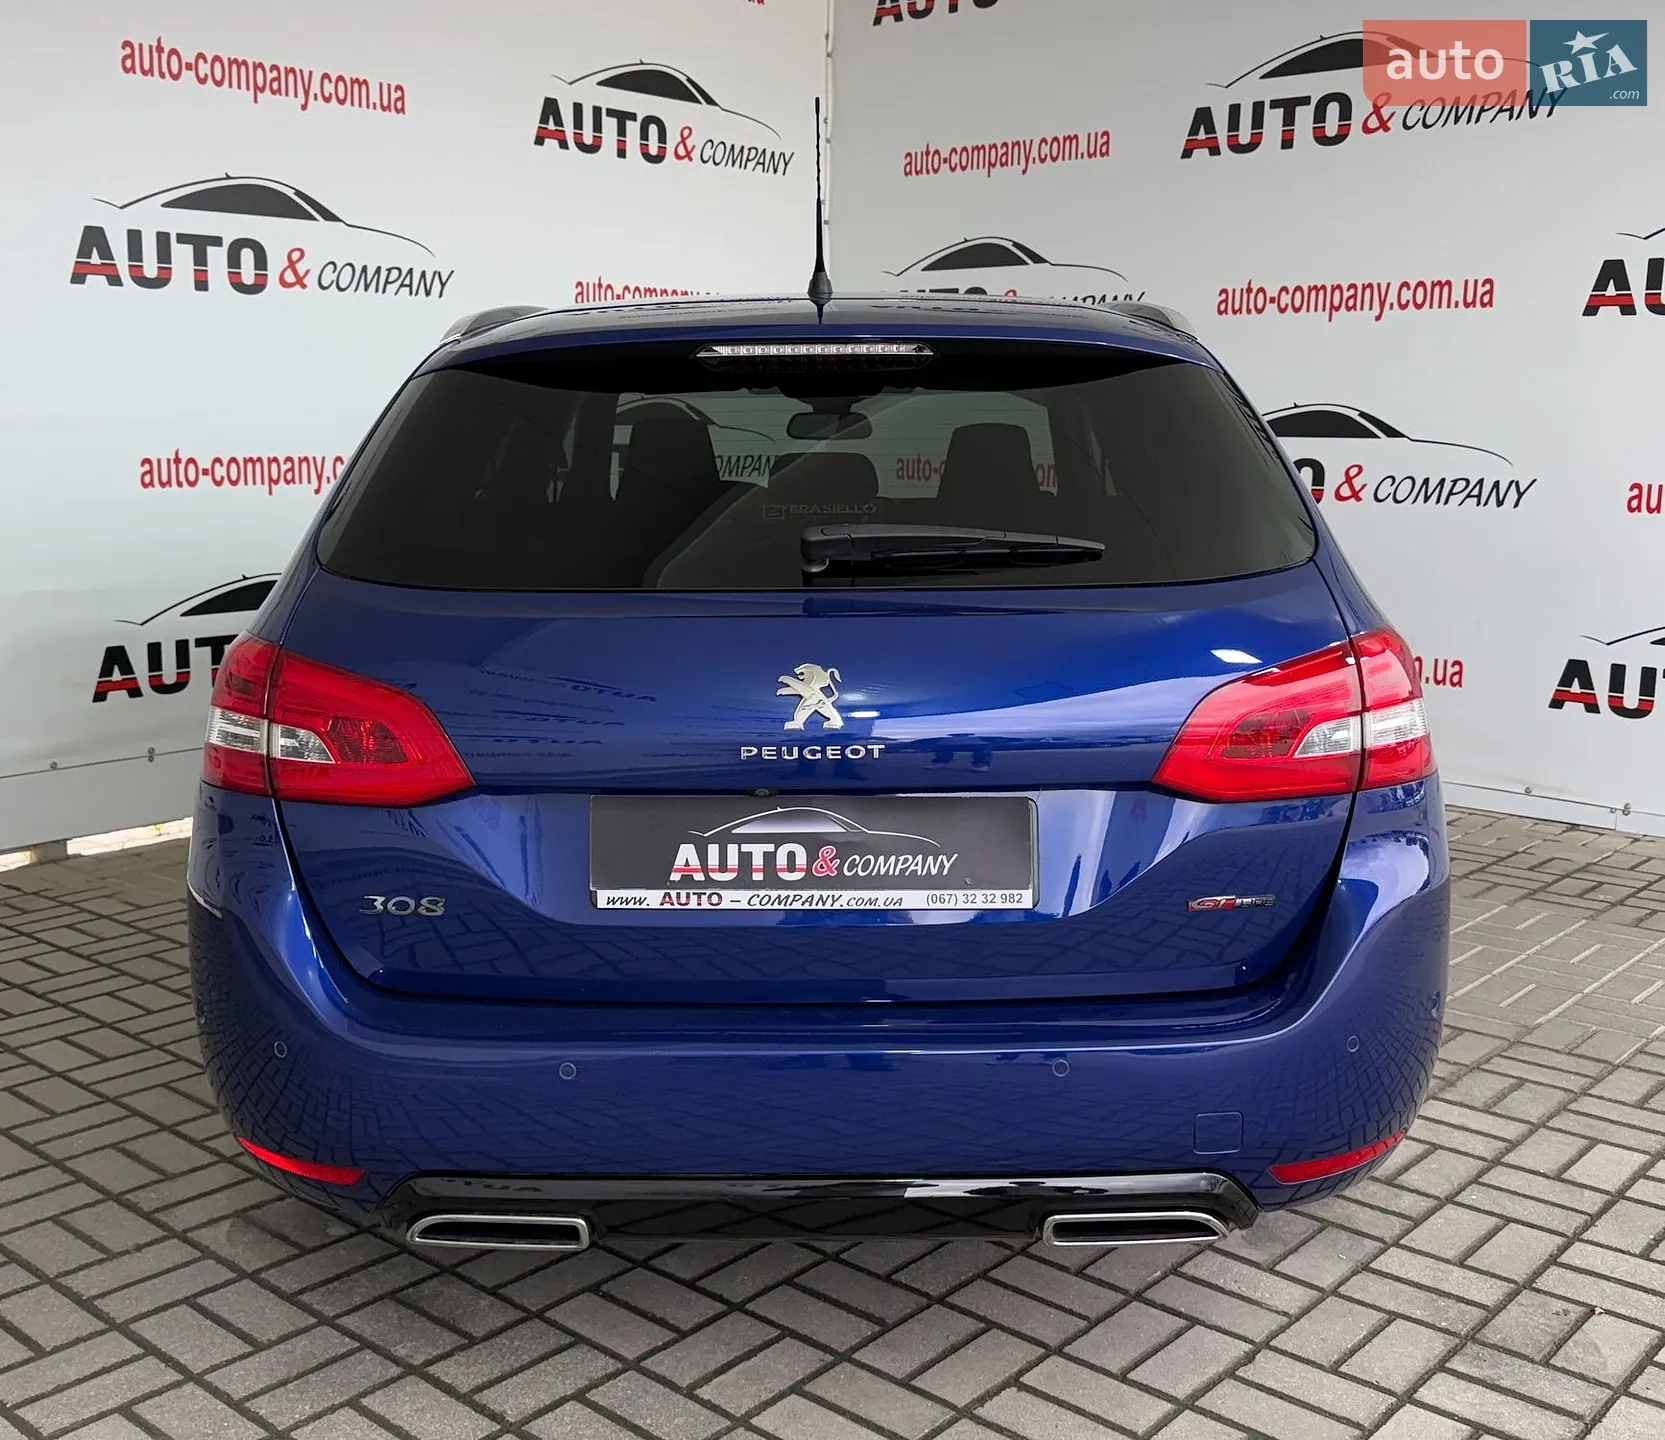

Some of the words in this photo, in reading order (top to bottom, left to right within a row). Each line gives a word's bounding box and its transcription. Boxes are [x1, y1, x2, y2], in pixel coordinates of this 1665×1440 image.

[121, 36, 406, 115] auto-company.com.ua
[534, 97, 667, 164] AUTO
[674, 126, 695, 162] &
[700, 139, 794, 177] COMPANY
[1180, 92, 1352, 159] AUTO
[1361, 92, 1396, 135] &
[1402, 84, 1570, 131] COMPANY
[904, 131, 1110, 177] auto-company.com.ua
[70, 225, 268, 295] AUTO
[278, 248, 310, 290] &
[317, 261, 454, 299] COMPANY
[1217, 278, 1494, 321] auto-company.com.ua
[1334, 464, 1367, 503] &
[1373, 475, 1536, 509] COMPANY
[1548, 658, 1665, 719] AU
[740, 744, 885, 760] PEUGEOT
[669, 843, 807, 882] AUTO
[812, 845, 840, 877] &
[843, 853, 958, 877] COMPANY
[359, 895, 446, 916] 308
[660, 892, 723, 906] AUTO
[926, 893, 958, 906] (067)
[962, 893, 977, 904] 32
[981, 893, 996, 904] 32
[1000, 893, 1023, 904] 982
